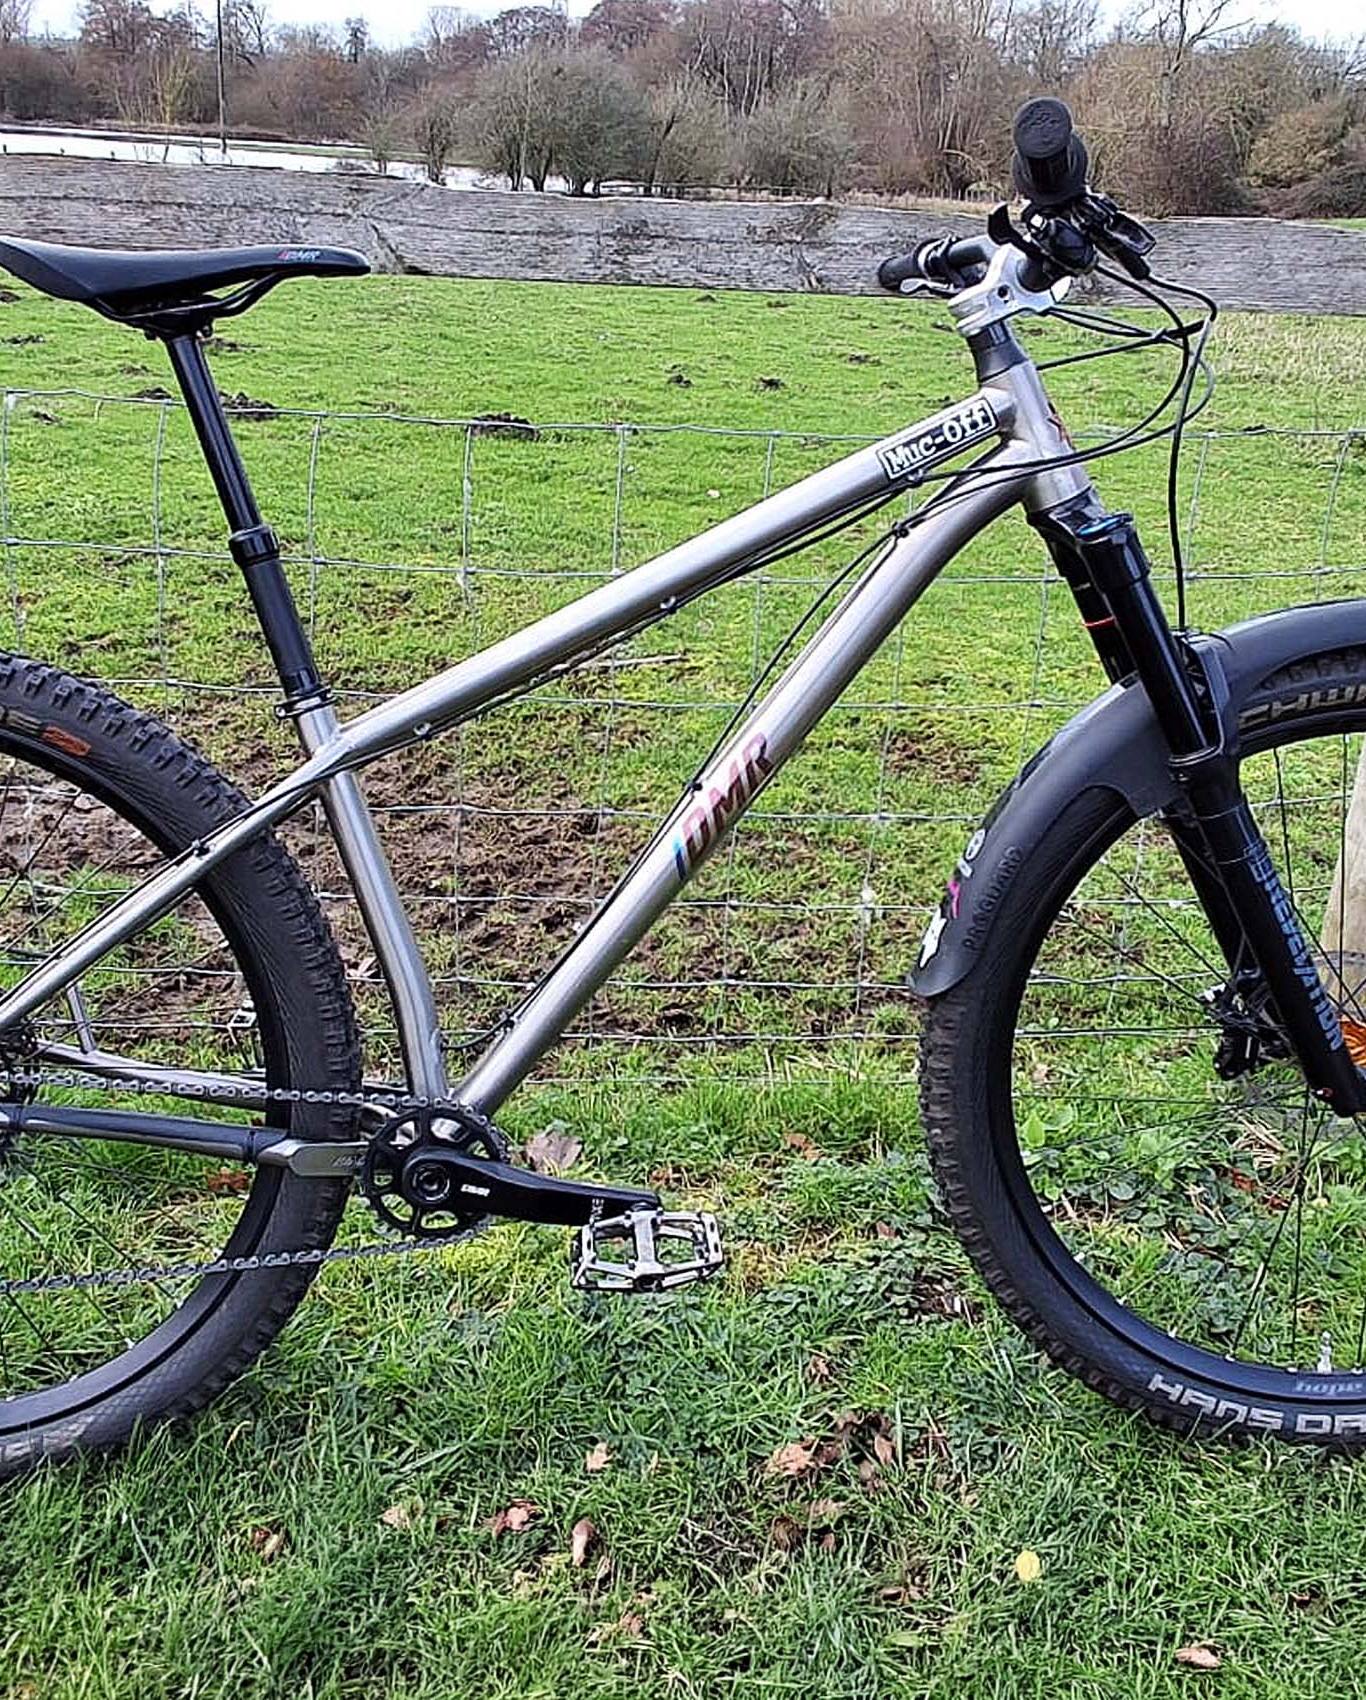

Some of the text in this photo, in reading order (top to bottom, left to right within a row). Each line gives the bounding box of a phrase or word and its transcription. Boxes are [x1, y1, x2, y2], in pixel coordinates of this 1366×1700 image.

[885, 402, 990, 472] Muc-Off
[682, 731, 775, 868] DMR
[1146, 1373, 1284, 1431] HANS
